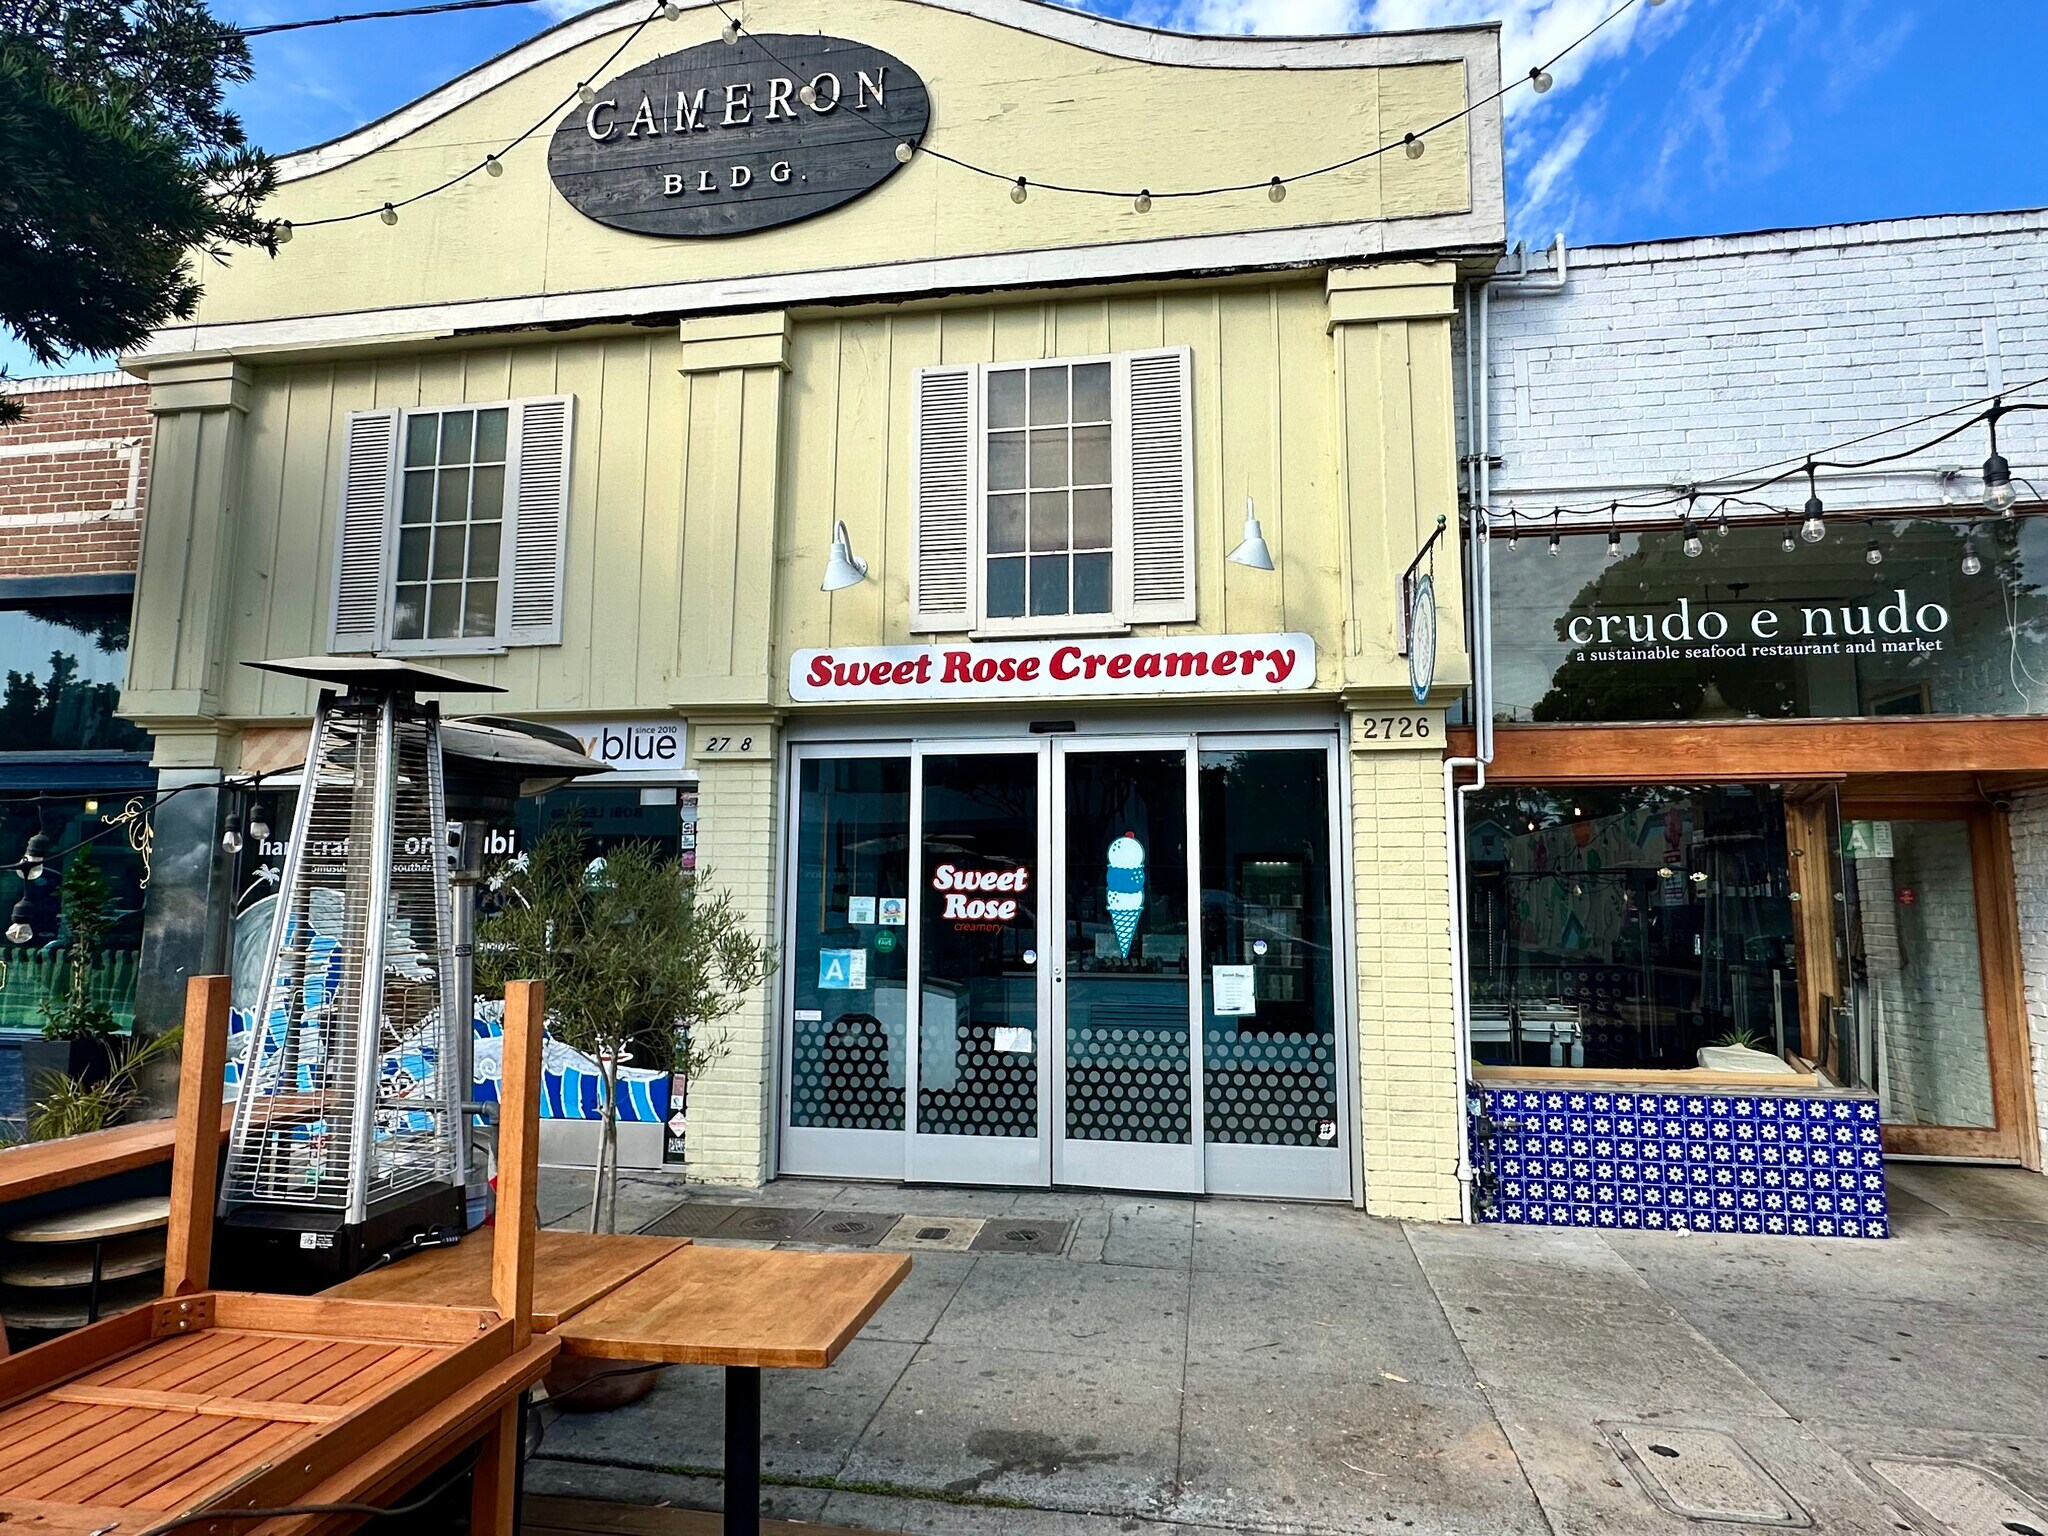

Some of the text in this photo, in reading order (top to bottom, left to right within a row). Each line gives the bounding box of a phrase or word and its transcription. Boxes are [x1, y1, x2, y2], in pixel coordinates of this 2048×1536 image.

[586, 67, 890, 142] CAMERON
[663, 161, 809, 196] BLDG.
[1567, 588, 1949, 644] crudo e nudo
[1576, 637, 1943, 661] a sustainable seafood restaurant and market
[806, 645, 1296, 688] Sweet Rose Creamery
[635, 725, 678, 734] since 2010
[1363, 716, 1430, 739] 2726
[1846, 829, 1868, 851] A
[933, 864, 1029, 892] Sweet
[942, 893, 1017, 920] Rose
[954, 922, 1005, 935] creamery
[824, 958, 845, 981] A
